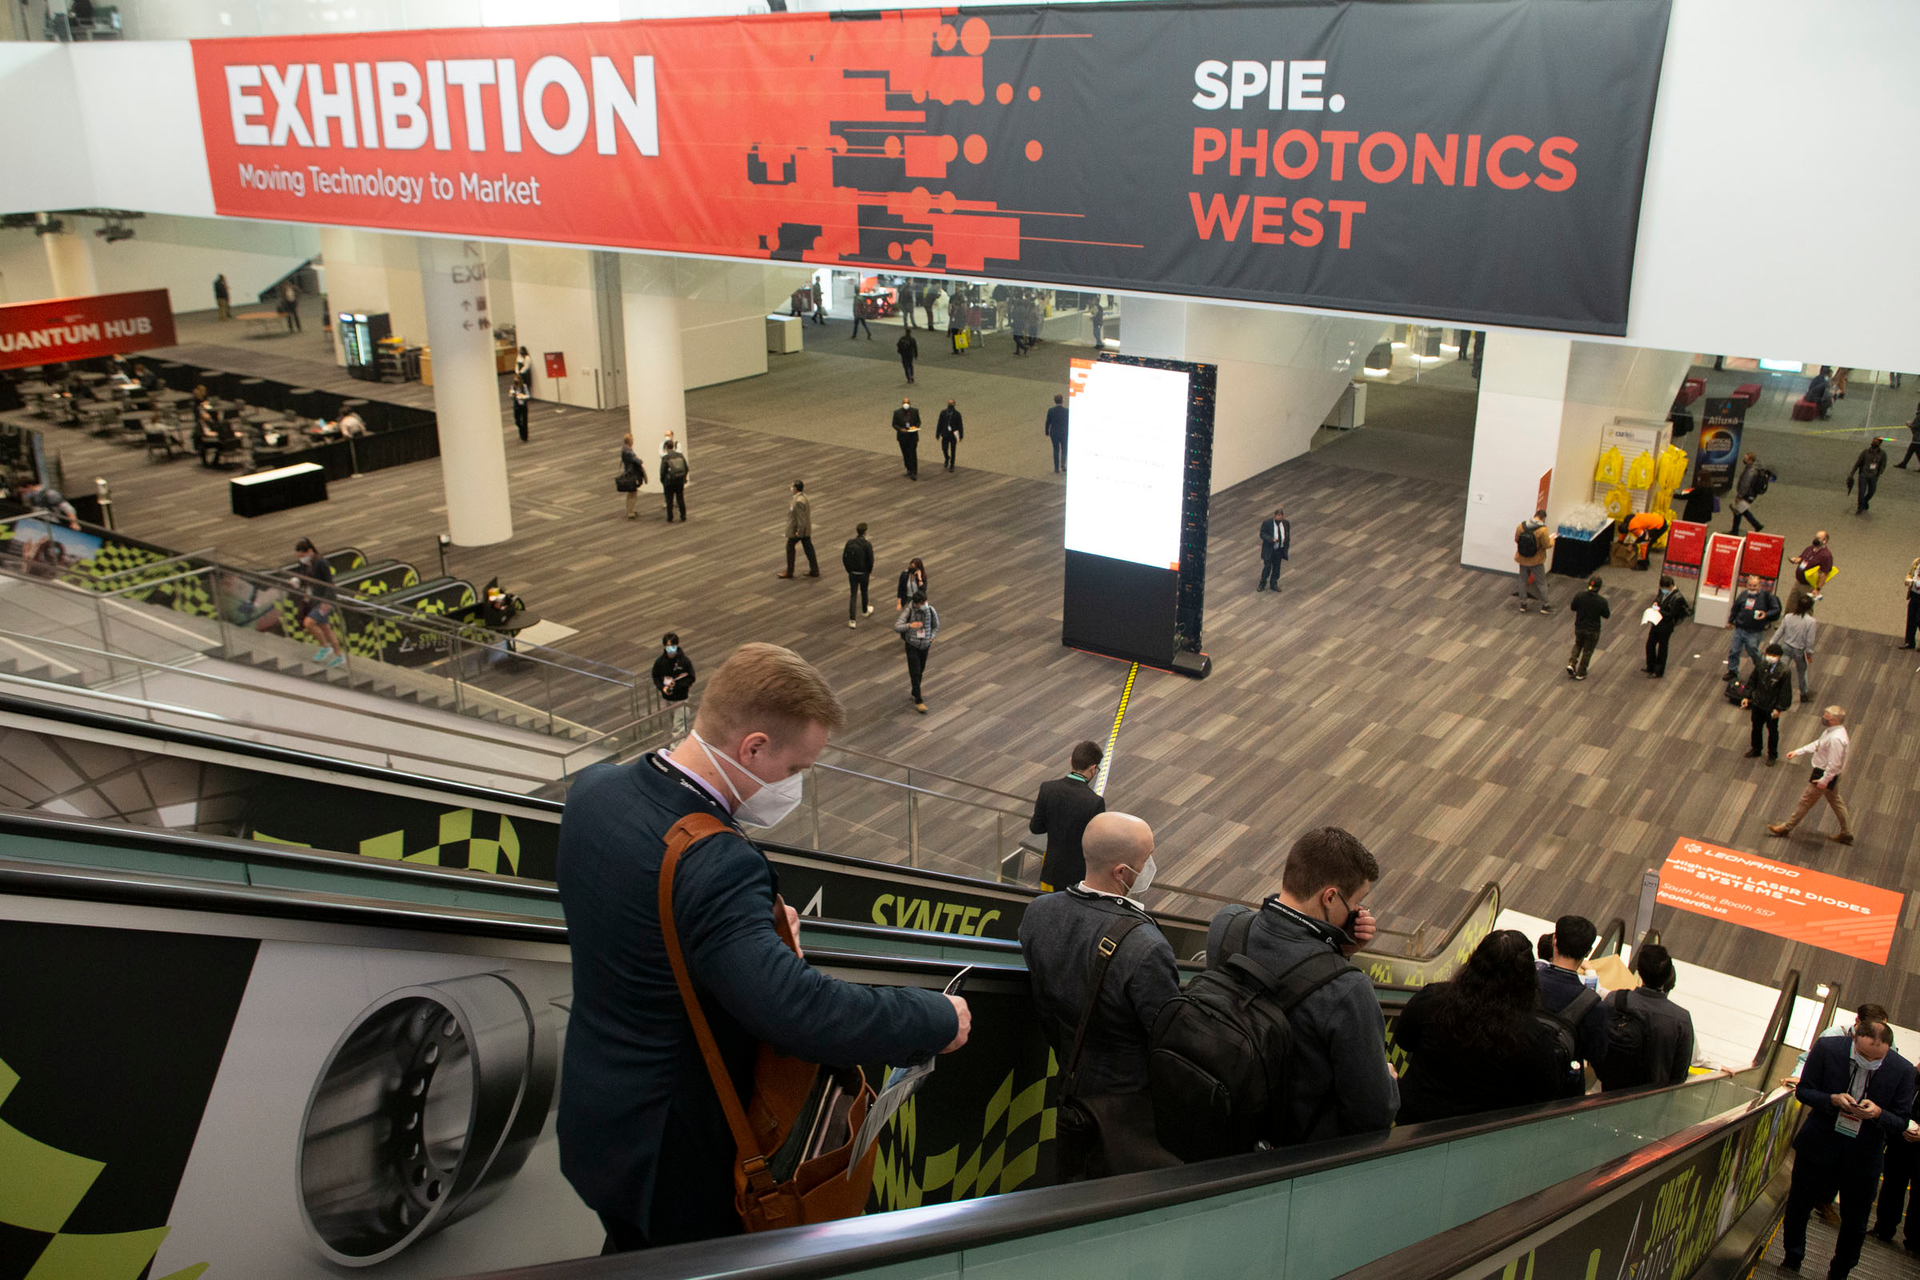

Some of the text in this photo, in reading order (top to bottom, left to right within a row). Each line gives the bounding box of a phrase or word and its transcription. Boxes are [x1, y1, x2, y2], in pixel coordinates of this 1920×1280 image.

[224, 54, 660, 157] EXHIBITION
[1192, 59, 1345, 113] SPIE.
[1192, 127, 1579, 192] PHOTONICS
[239, 163, 541, 206] Moving Technology to Market
[1188, 192, 1366, 249] WEST
[0, 316, 152, 353] UANTUM HUB
[1672, 863, 1784, 900] and SYSTEMS
[1704, 849, 1800, 878] LEONARDO
[1657, 890, 1729, 915] leonardo.us
[1661, 882, 1692, 897] South
[1694, 890, 1717, 904] Hall,
[1719, 897, 1753, 912] Booth
[1754, 906, 1776, 918] 557
[1675, 858, 1872, 915] High-Power LASER DIODES
[871, 893, 1001, 938] SYNTEC
